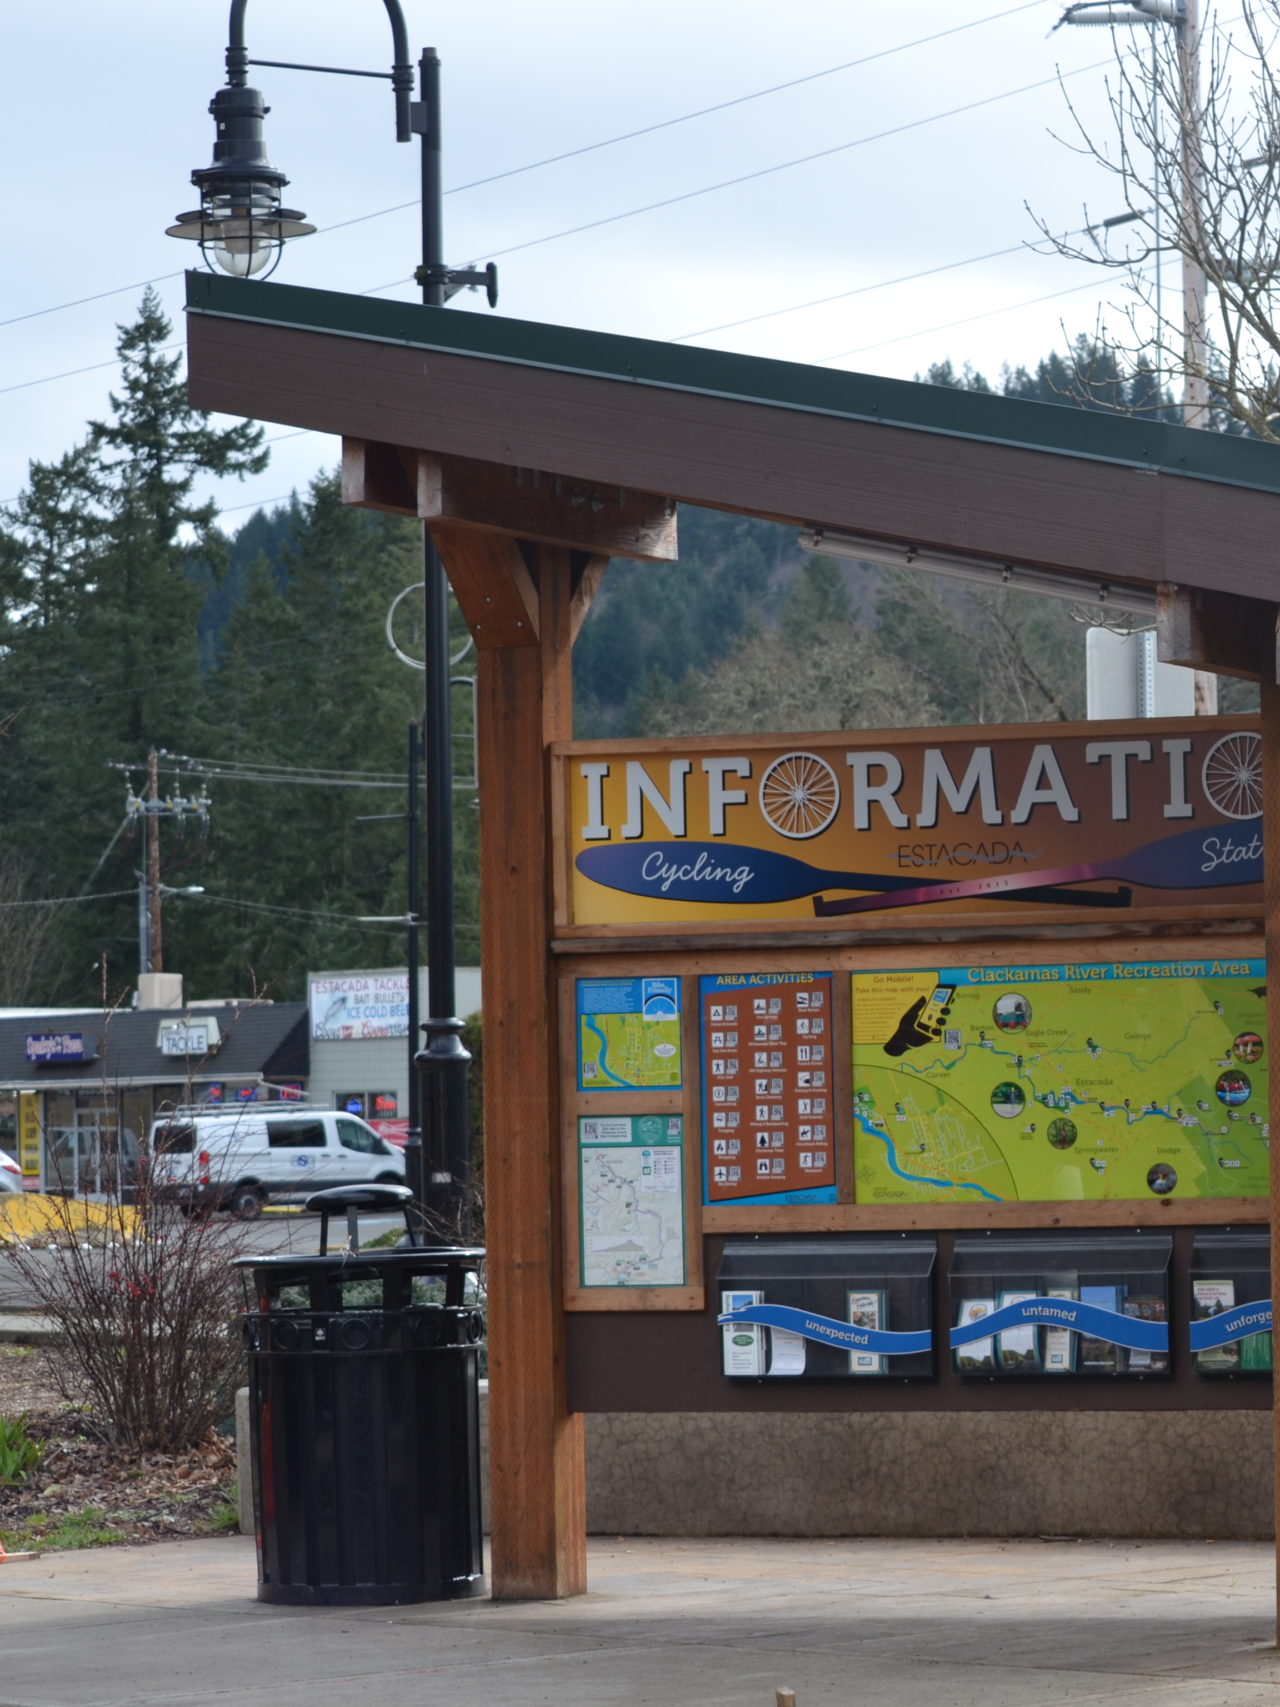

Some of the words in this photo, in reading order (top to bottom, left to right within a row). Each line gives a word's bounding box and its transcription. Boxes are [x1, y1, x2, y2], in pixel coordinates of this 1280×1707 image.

[897, 841, 1028, 868] ESTACADA
[641, 851, 756, 893] Cycling
[716, 975, 747, 986] AREA
[749, 972, 815, 985] ACTIVITIES
[886, 975, 914, 983] Mobile!
[967, 967, 1060, 983] Clackamas
[1064, 964, 1108, 980] River
[1113, 962, 1206, 978] Recreation
[1210, 961, 1251, 976] Area
[316, 980, 369, 993] ESTACADA
[354, 993, 370, 1005] BAIT
[347, 1007, 361, 1019] ICE
[363, 1005, 388, 1018] COLD
[390, 1004, 409, 1016] BEE
[1075, 1077, 1114, 1086] Estacada
[1157, 1146, 1181, 1155] Dodge
[1021, 1305, 1077, 1321] untamed
[805, 1319, 869, 1345] unexpected
